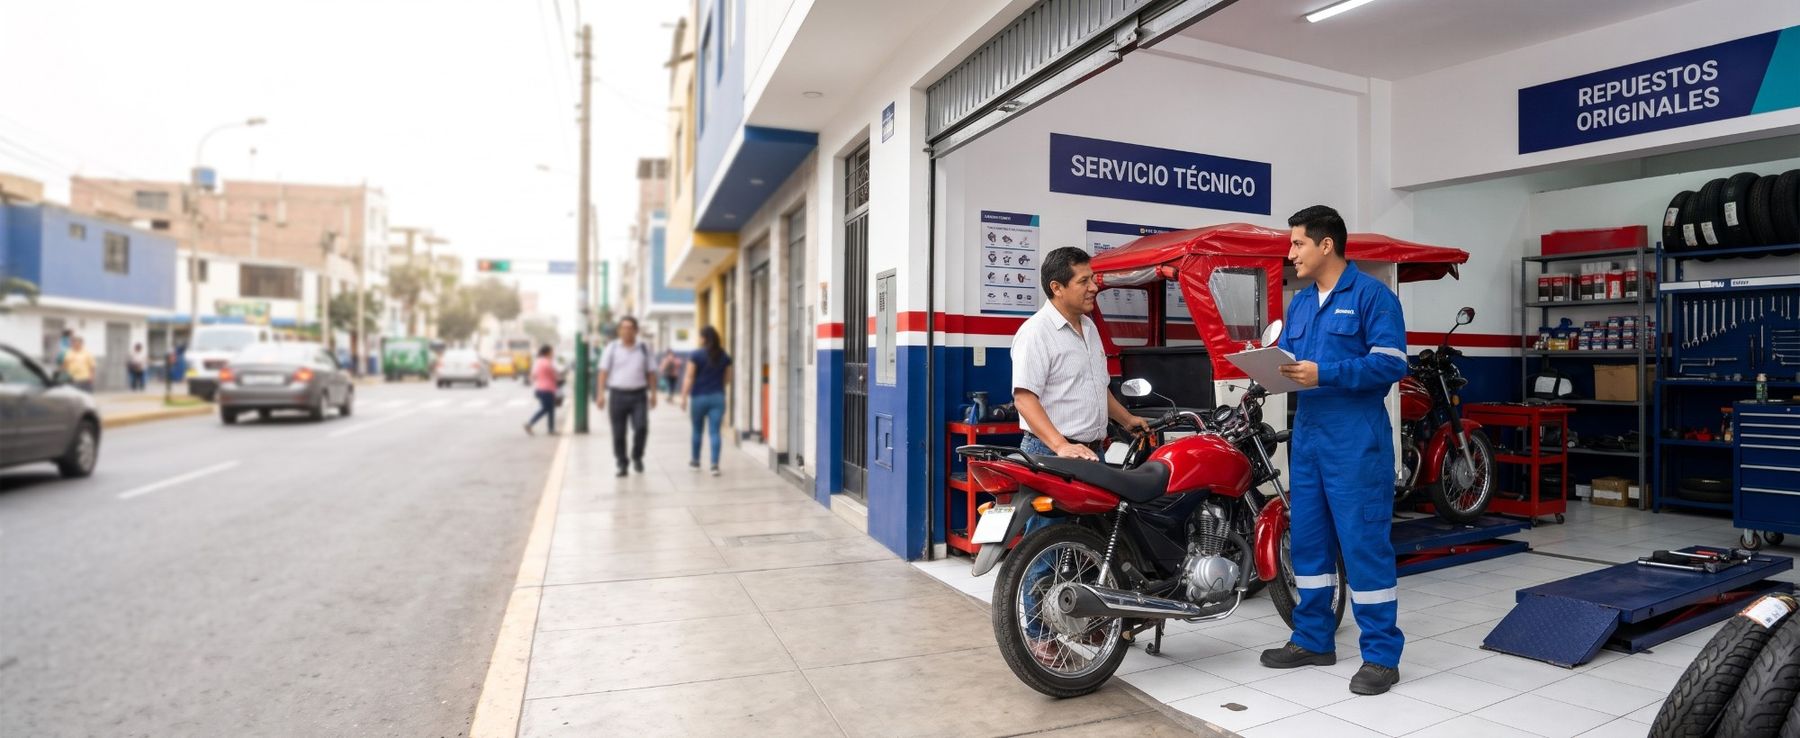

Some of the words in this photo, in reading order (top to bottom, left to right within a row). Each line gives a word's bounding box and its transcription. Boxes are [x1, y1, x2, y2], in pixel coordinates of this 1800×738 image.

[1578, 60, 1718, 106] REPUESTOS
[1577, 86, 1720, 131] ORIGINALES
[1071, 155, 1168, 186] SERVICIO
[1173, 165, 1255, 197] TÉCNICO
